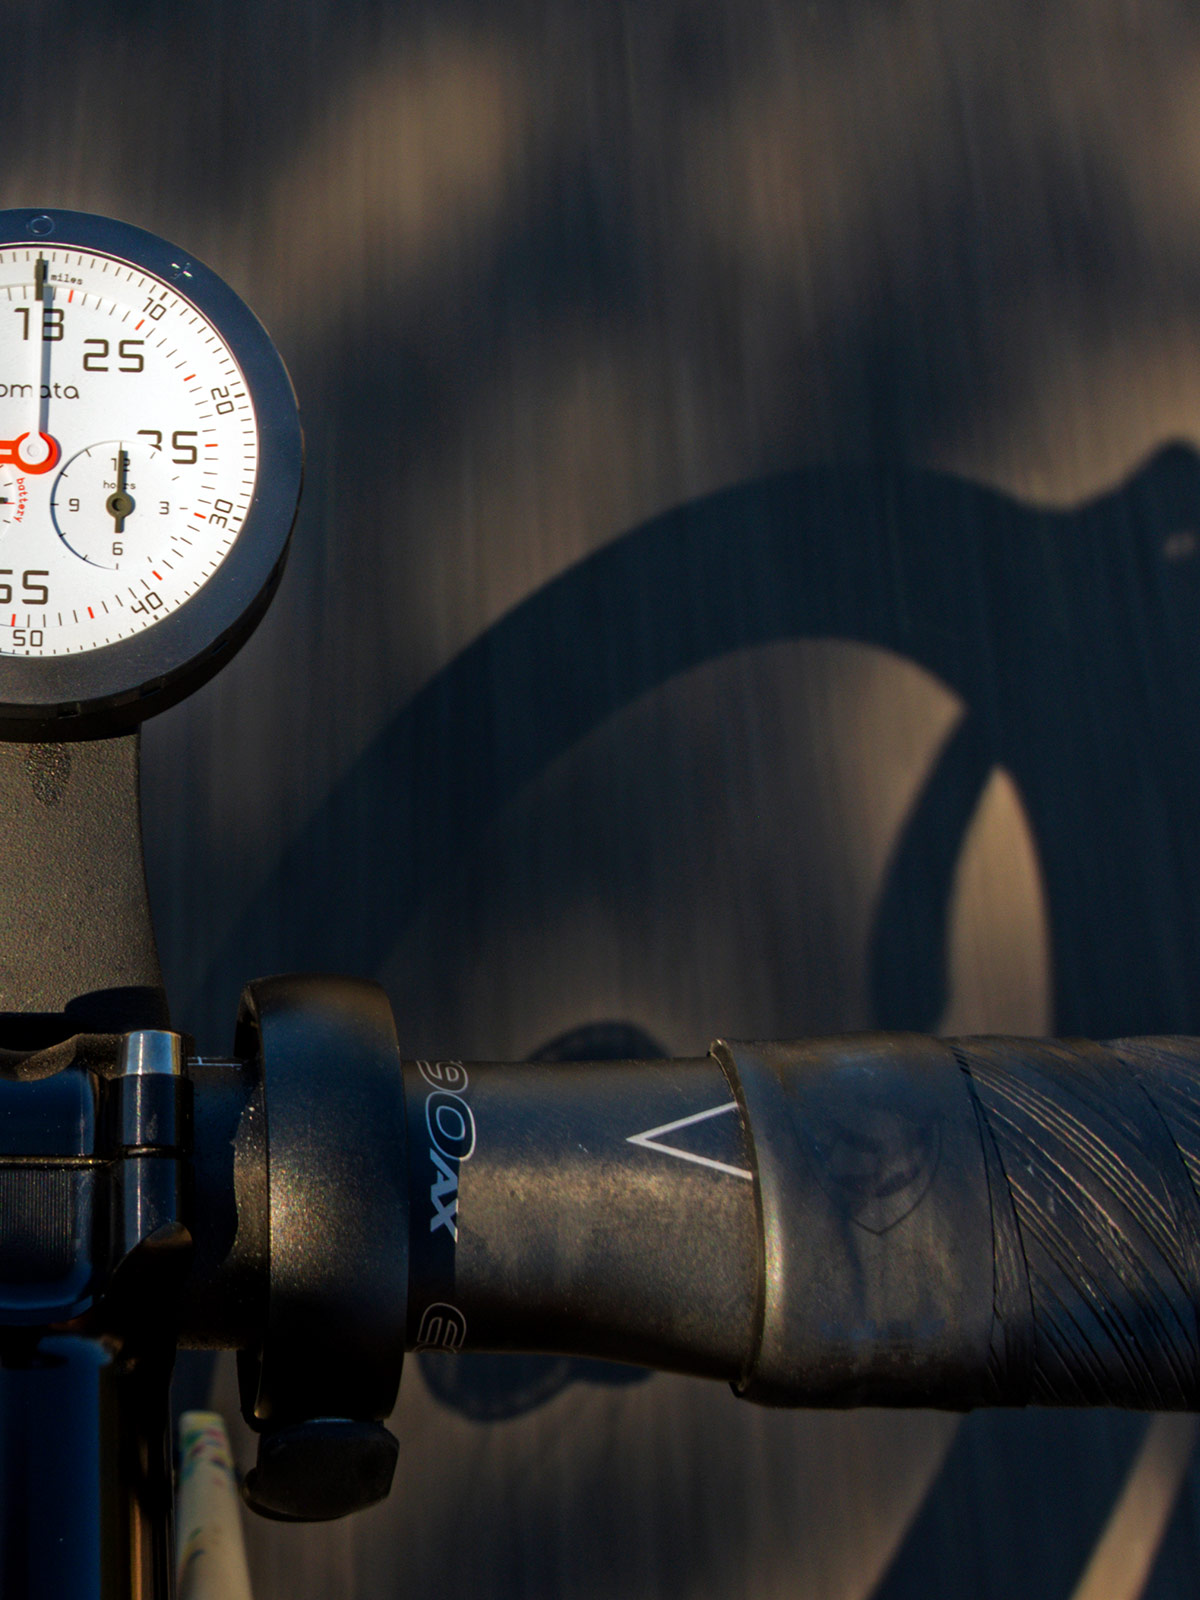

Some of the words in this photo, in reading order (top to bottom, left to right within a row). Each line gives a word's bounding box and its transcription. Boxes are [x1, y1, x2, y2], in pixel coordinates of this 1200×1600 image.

[50, 273, 83, 286] miles
[143, 297, 167, 321] 10
[83, 338, 145, 373] 25
[210, 386, 235, 415] 20
[103, 480, 137, 490] hors
[13, 477, 29, 523] battery
[68, 498, 80, 512] 9
[159, 501, 170, 515] 3
[208, 498, 234, 529] 30
[112, 541, 124, 556] 6
[130, 592, 164, 615] 40
[12, 629, 44, 647] 50
